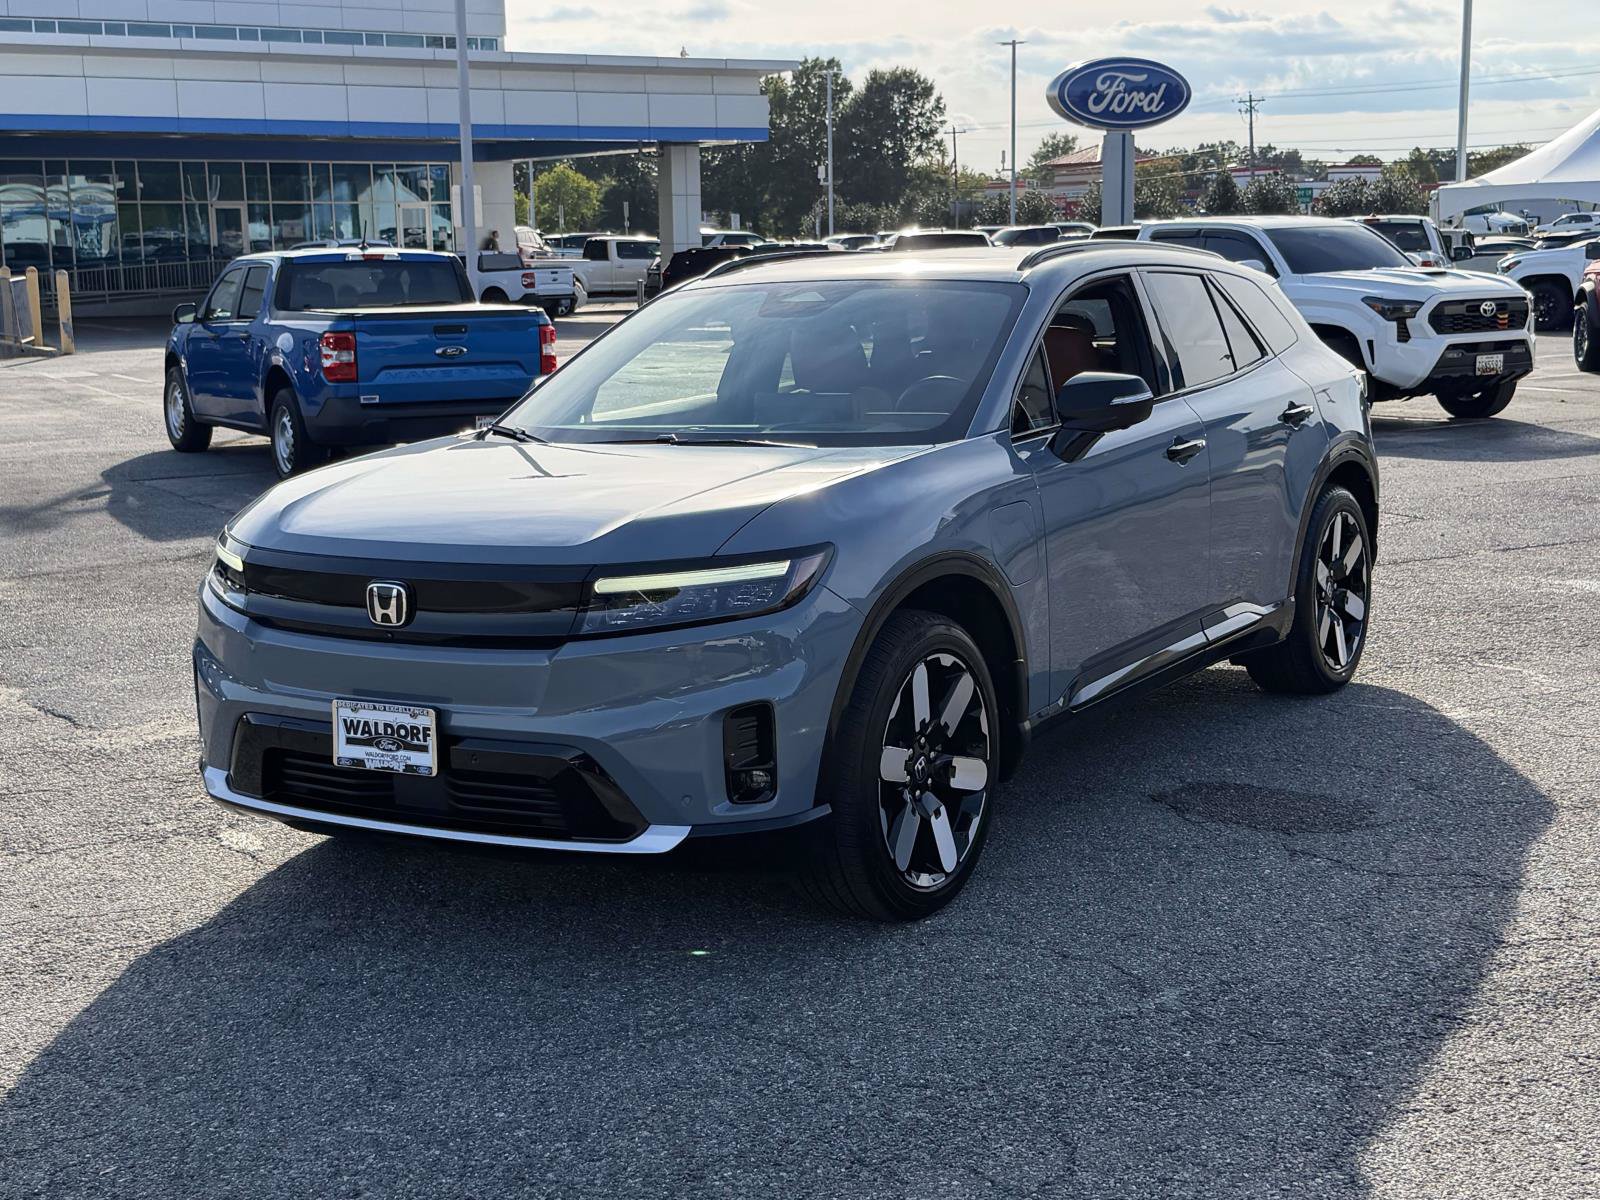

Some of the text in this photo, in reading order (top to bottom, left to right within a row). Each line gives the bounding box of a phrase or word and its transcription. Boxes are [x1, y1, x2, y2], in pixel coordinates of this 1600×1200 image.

[1088, 72, 1167, 113] Ford
[337, 702, 374, 710] DEDICATED
[386, 706, 429, 716] EXCELLENCE
[342, 718, 431, 743] WALDORF
[379, 740, 398, 751] Ford
